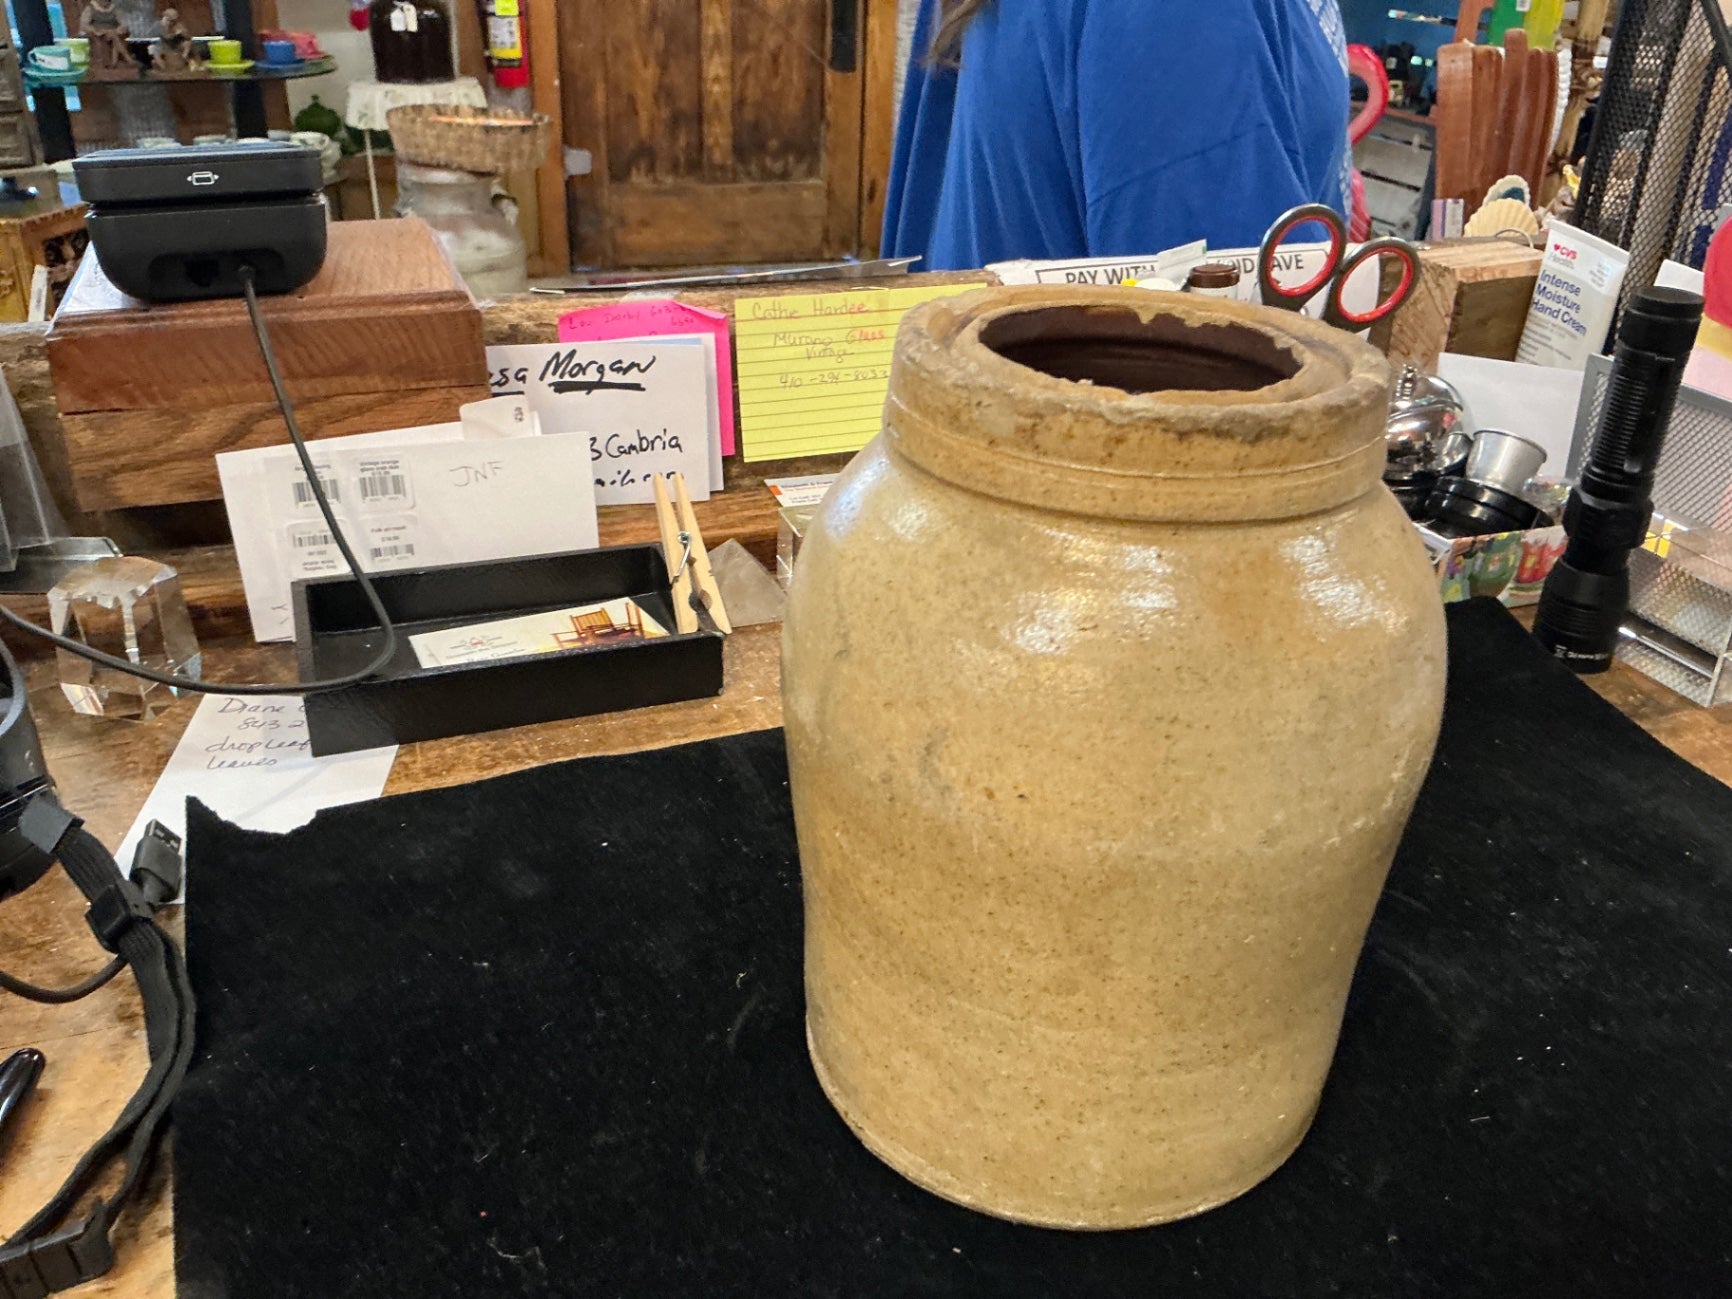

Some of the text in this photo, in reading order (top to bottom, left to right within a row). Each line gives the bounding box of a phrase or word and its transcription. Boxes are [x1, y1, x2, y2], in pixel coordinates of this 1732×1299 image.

[1560, 246, 1577, 260] CVS
[1065, 270, 1098, 284] PAY
[1271, 254, 1304, 271] AVE
[1540, 269, 1581, 297] Intense
[1535, 283, 1580, 314] Moisture
[1532, 298, 1562, 319] Hand
[1560, 311, 1587, 336] Cream
[539, 349, 657, 395] Morgan
[605, 428, 683, 458] Cambria
[449, 460, 504, 487] JNF
